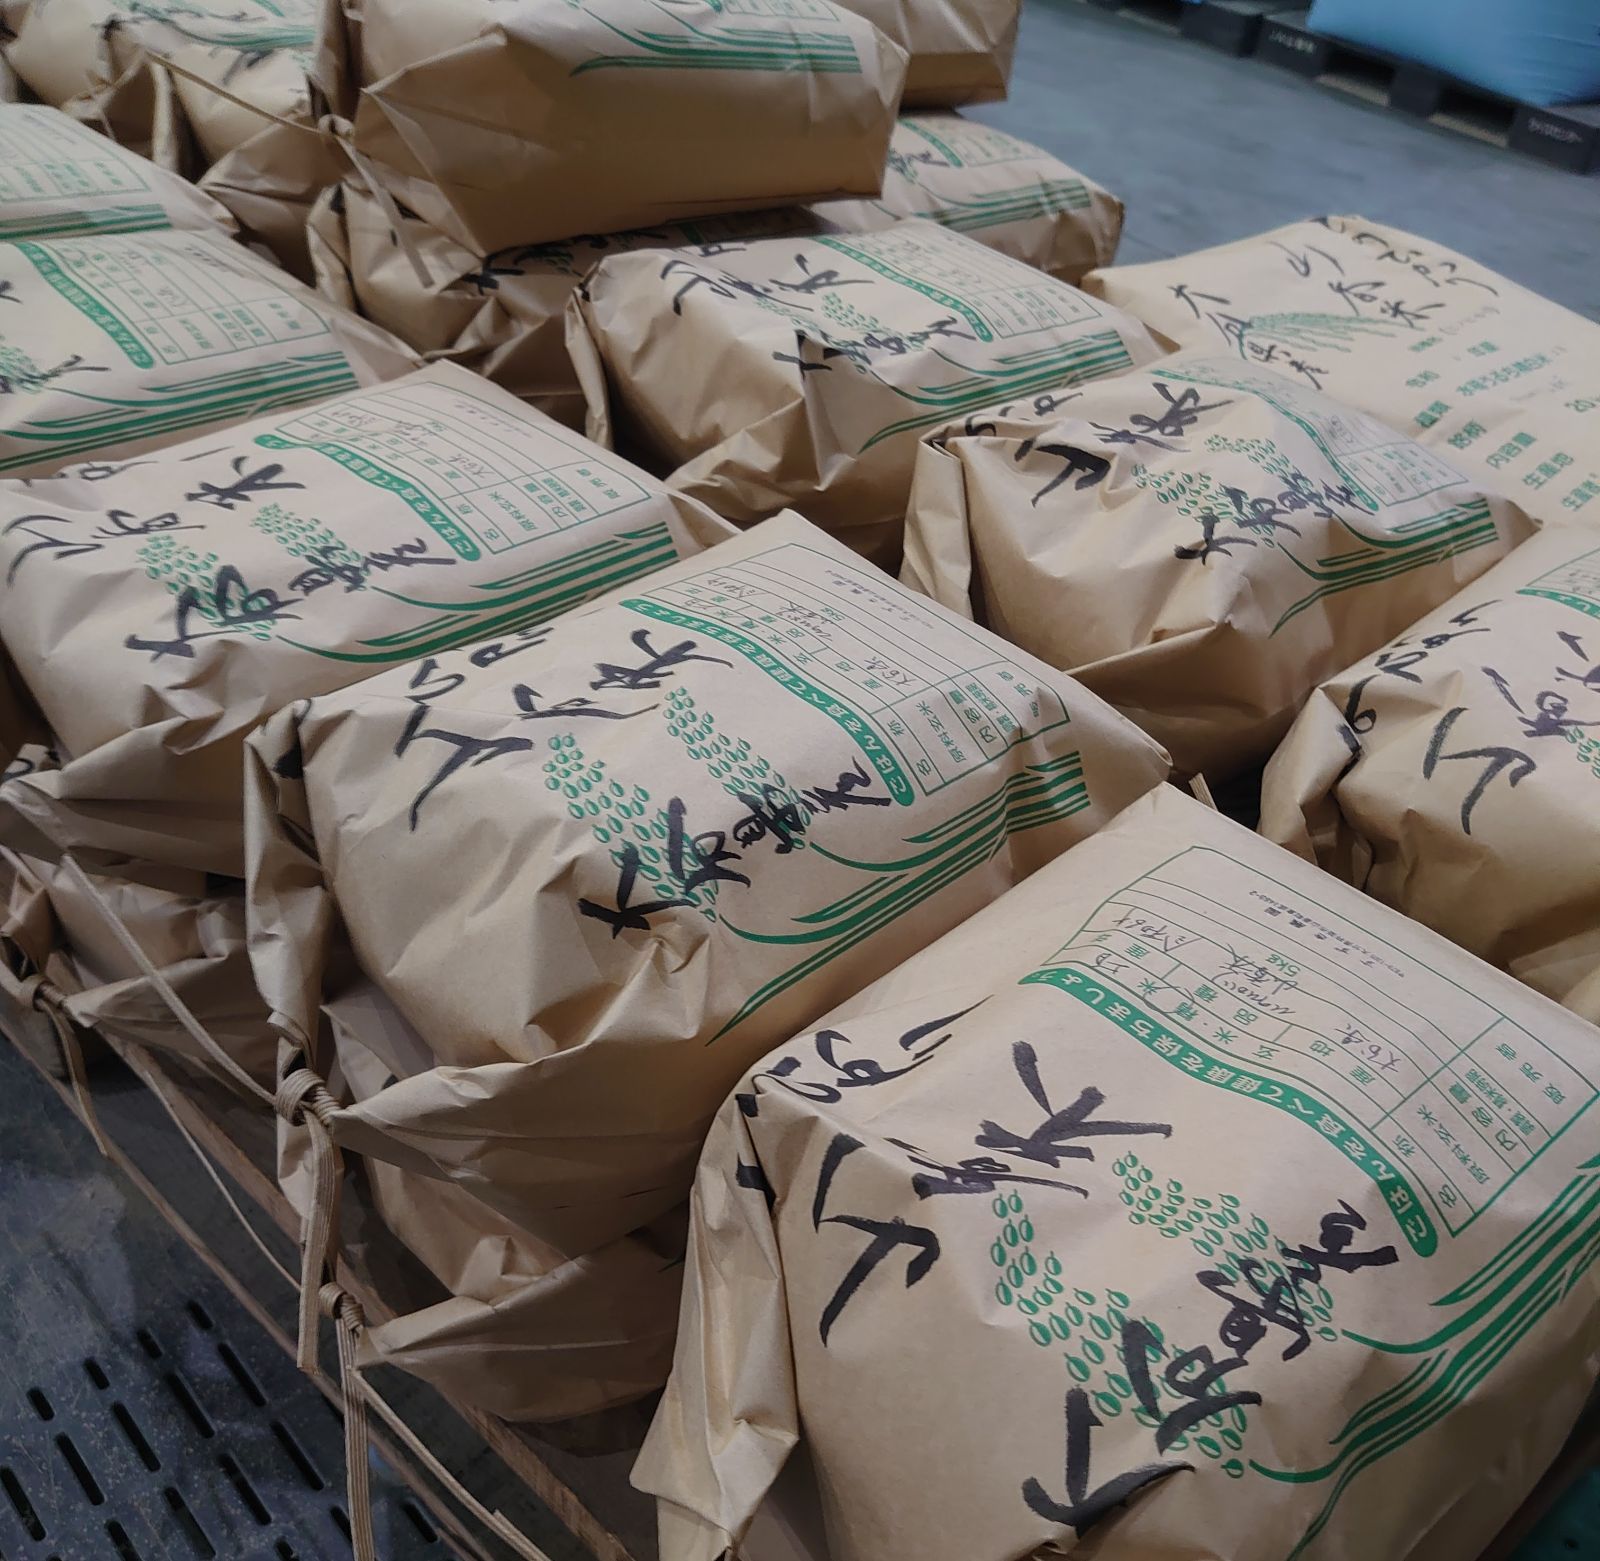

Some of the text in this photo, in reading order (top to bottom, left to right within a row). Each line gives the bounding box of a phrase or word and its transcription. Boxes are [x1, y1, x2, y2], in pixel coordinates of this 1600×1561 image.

[1486, 432, 1537, 469] 内容量
[1522, 452, 1574, 490] 生産地
[914, 702, 967, 764] 原料玄米
[948, 689, 997, 746] 内容量
[890, 719, 932, 776] 名称
[1264, 953, 1302, 974] 5kg
[1194, 980, 1260, 1025] 品種
[1310, 1039, 1376, 1086] 産地
[1495, 1041, 1567, 1107] 販売者
[1416, 1104, 1491, 1185] 原料玄米
[1448, 1082, 1519, 1153] 内容量
[1401, 1133, 1460, 1210] 名称
[1020, 1198, 1400, 1537] 大分県産
